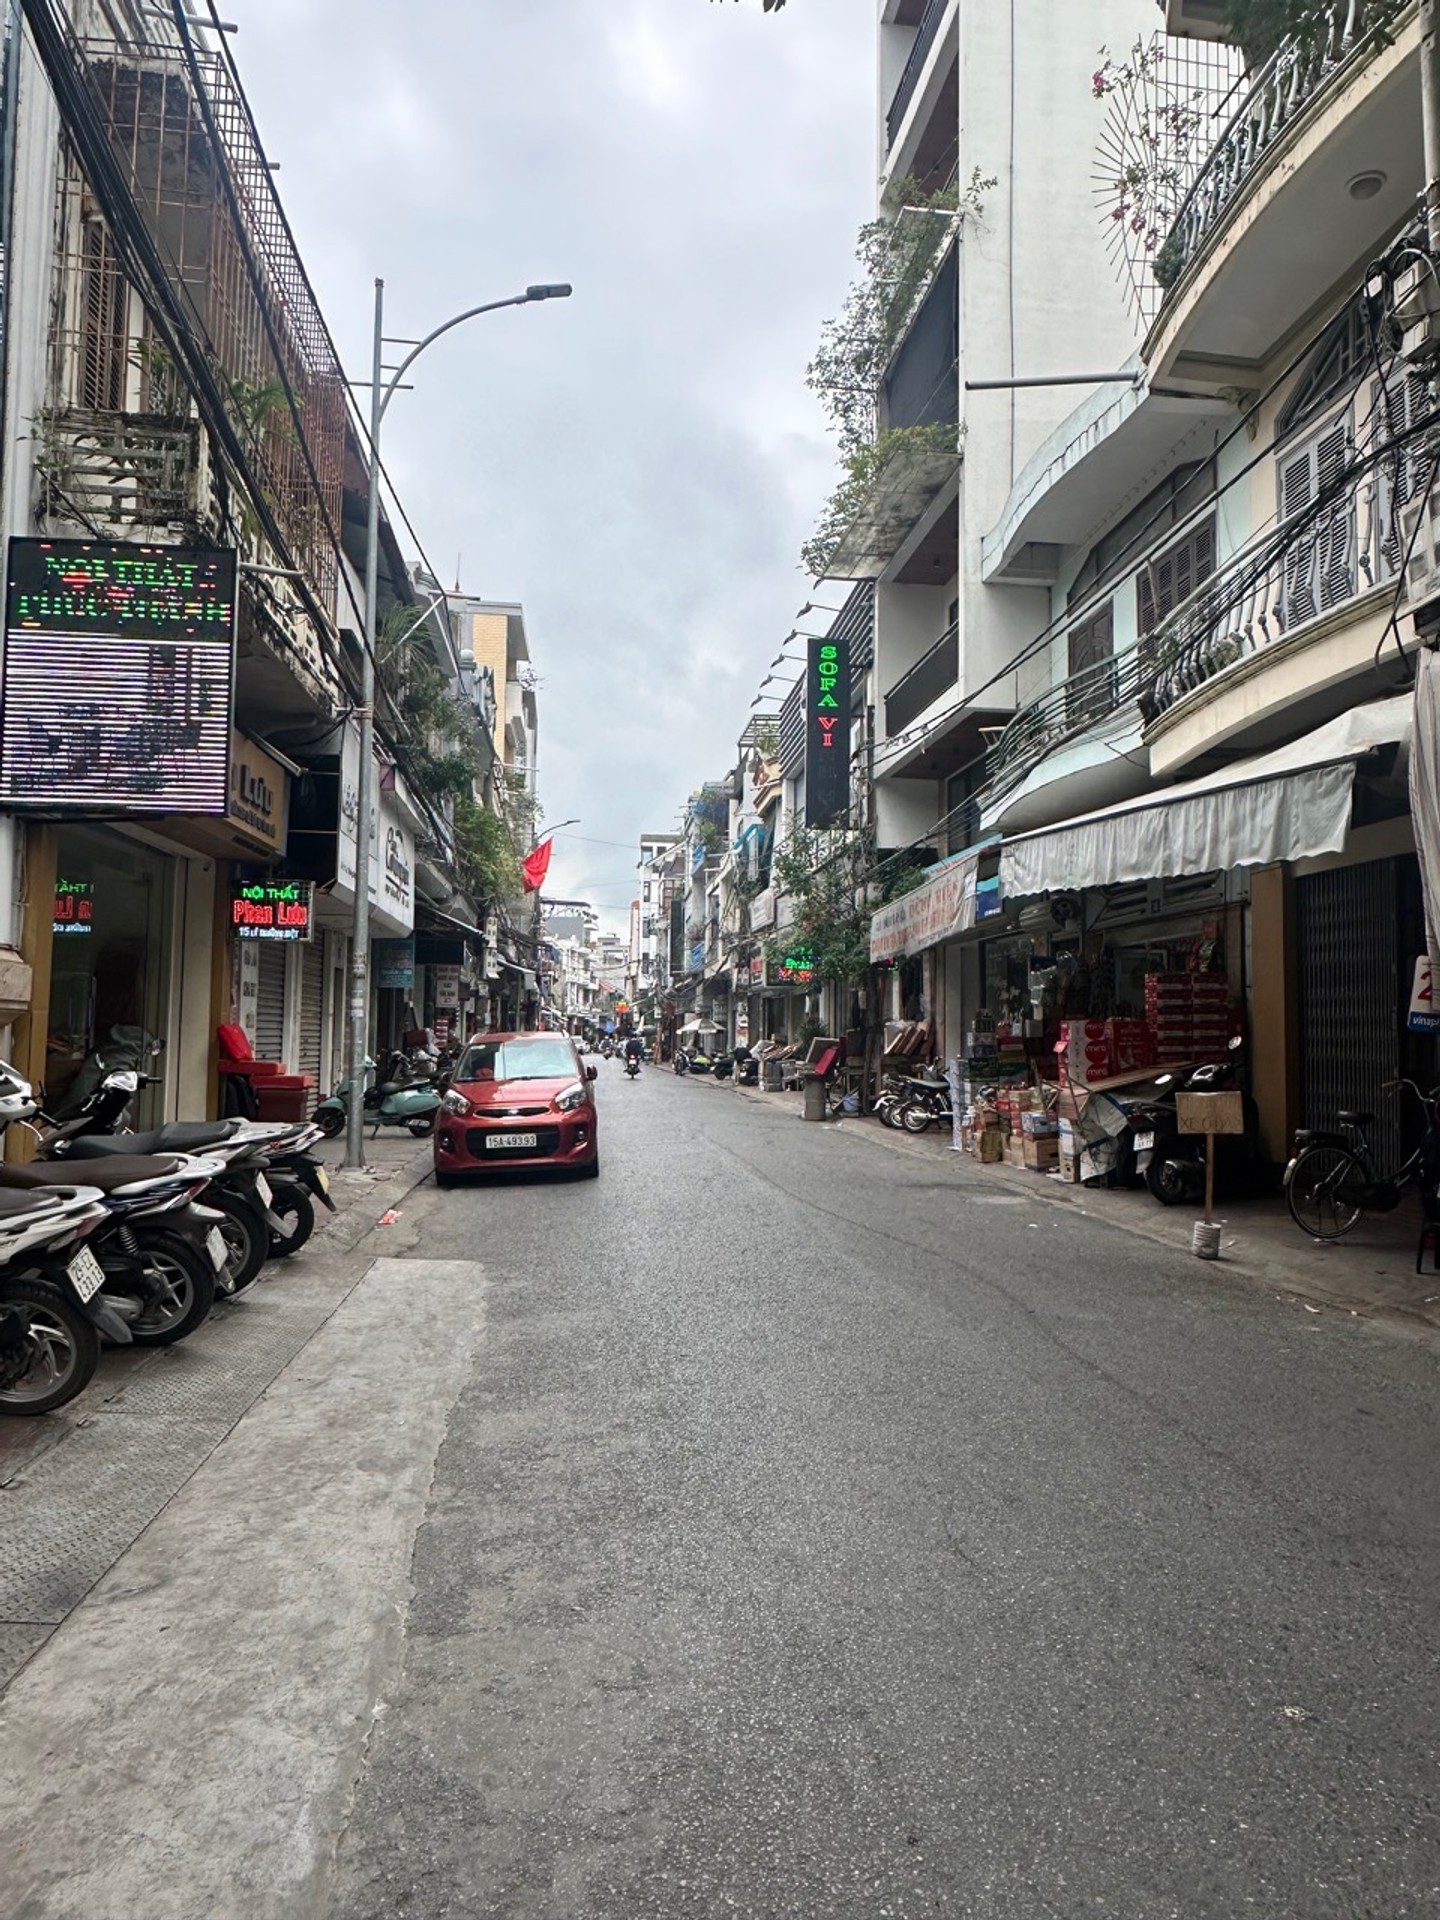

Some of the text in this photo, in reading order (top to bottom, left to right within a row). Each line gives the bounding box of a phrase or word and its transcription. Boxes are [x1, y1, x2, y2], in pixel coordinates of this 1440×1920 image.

[818, 646, 838, 707] SOFA
[243, 884, 299, 899] NỘI THẤT
[234, 900, 272, 923] Phan
